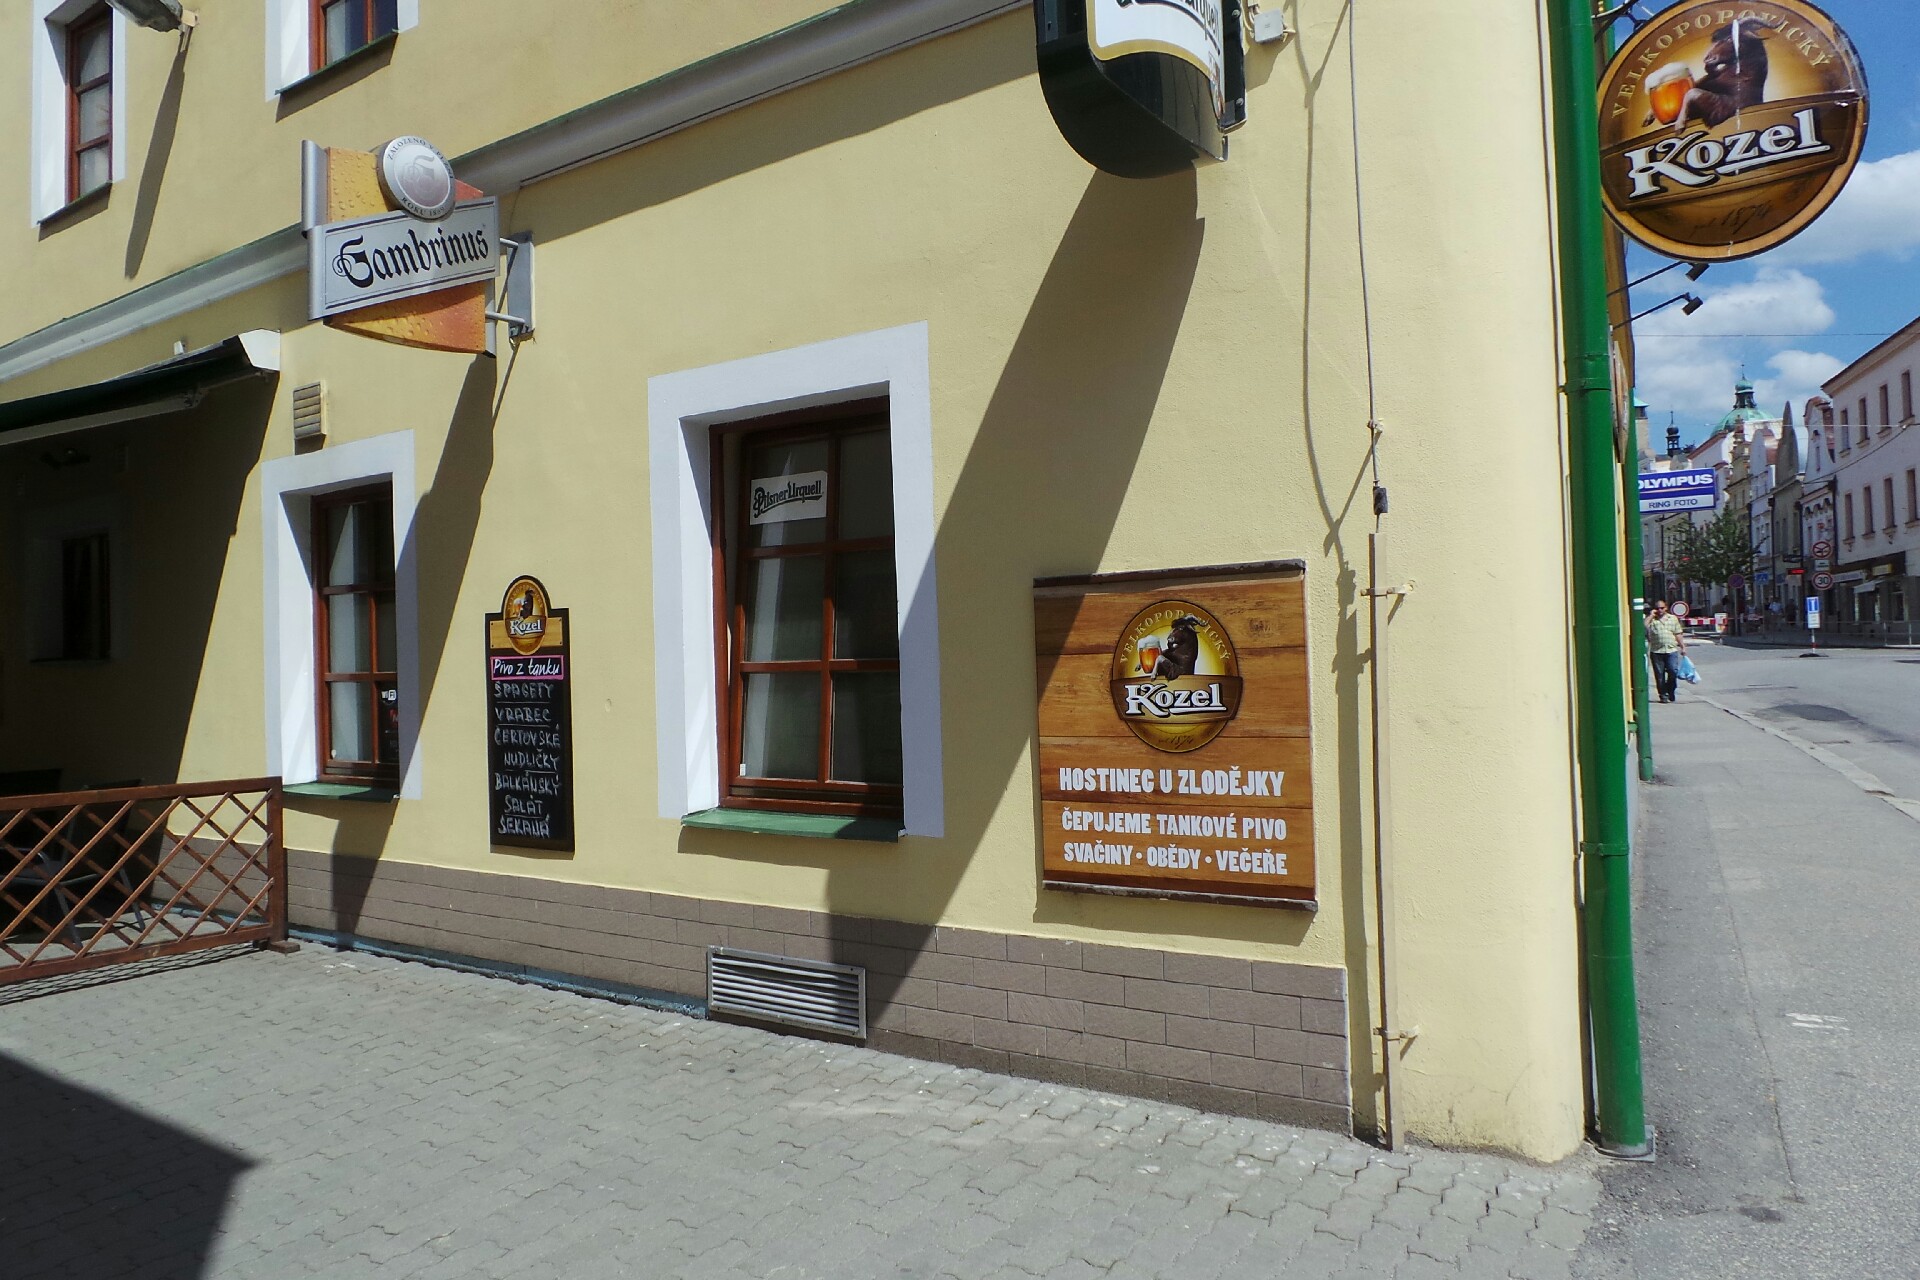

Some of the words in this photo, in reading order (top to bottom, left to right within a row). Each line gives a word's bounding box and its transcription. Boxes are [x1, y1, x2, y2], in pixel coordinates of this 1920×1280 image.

[1624, 108, 1831, 199] Kozel
[332, 227, 489, 289] Gambrinus
[753, 486, 789, 519] Pilsner
[787, 480, 822, 503] Urquell
[1649, 500, 1671, 509] RING
[1674, 498, 1698, 507] FOTO
[1817, 576, 1829, 585] 30
[510, 619, 543, 635] Kozel
[494, 706, 552, 723] VRABEC
[1124, 682, 1228, 719] Kozel
[1059, 767, 1155, 793] HOSTINEC
[1159, 769, 1173, 793] U
[1178, 765, 1285, 797] ZLODĚJKY
[1062, 806, 1152, 834] ČEPUJEME
[1156, 812, 1238, 839] TANKOVÉ
[1242, 817, 1288, 841] PIVO
[1063, 840, 1134, 866] SVAČINY
[1147, 843, 1202, 870] OBĚDY
[1216, 848, 1288, 876] VEČEŘE
